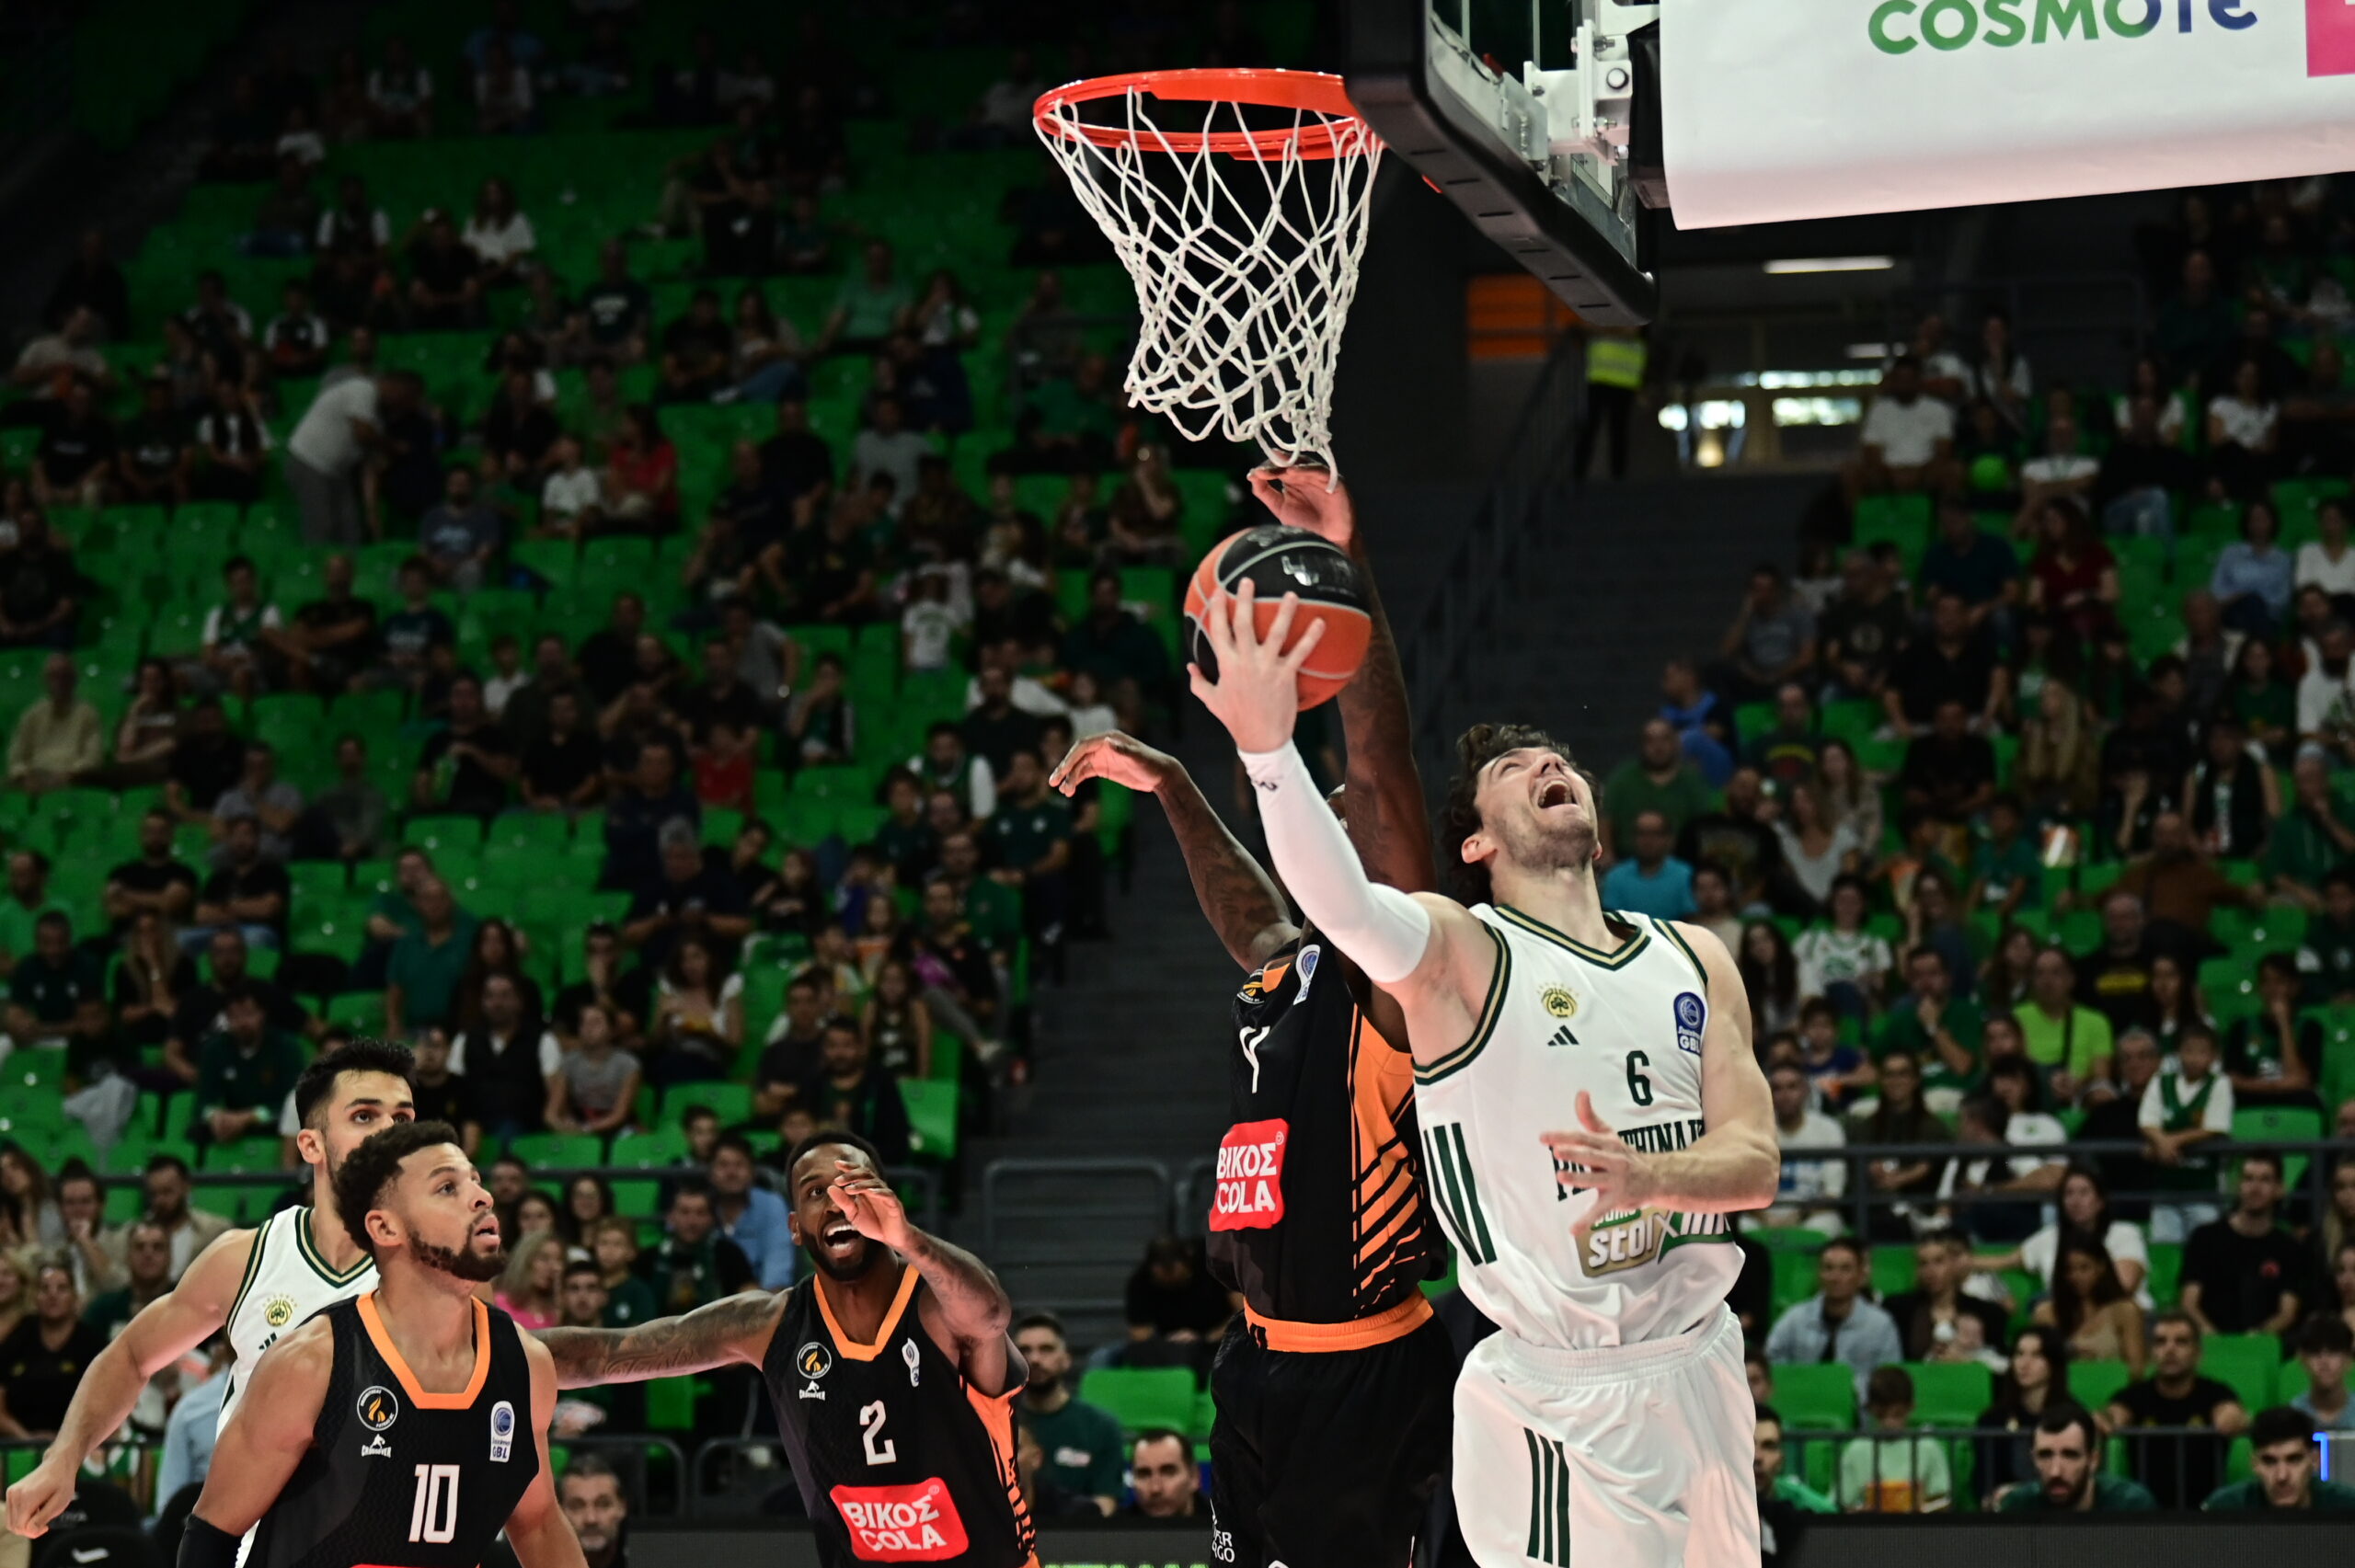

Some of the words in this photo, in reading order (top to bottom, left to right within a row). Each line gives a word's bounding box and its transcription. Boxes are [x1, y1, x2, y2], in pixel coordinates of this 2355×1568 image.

[1626, 1050, 1654, 1106] 6
[1216, 1142, 1278, 1180] ΒΙΚΟΣ
[1216, 1180, 1276, 1214] COLA
[859, 1400, 897, 1466] 2
[408, 1463, 461, 1544] 10
[842, 1494, 940, 1529] ΒΙΚΟΣ
[858, 1523, 948, 1552] COLA
